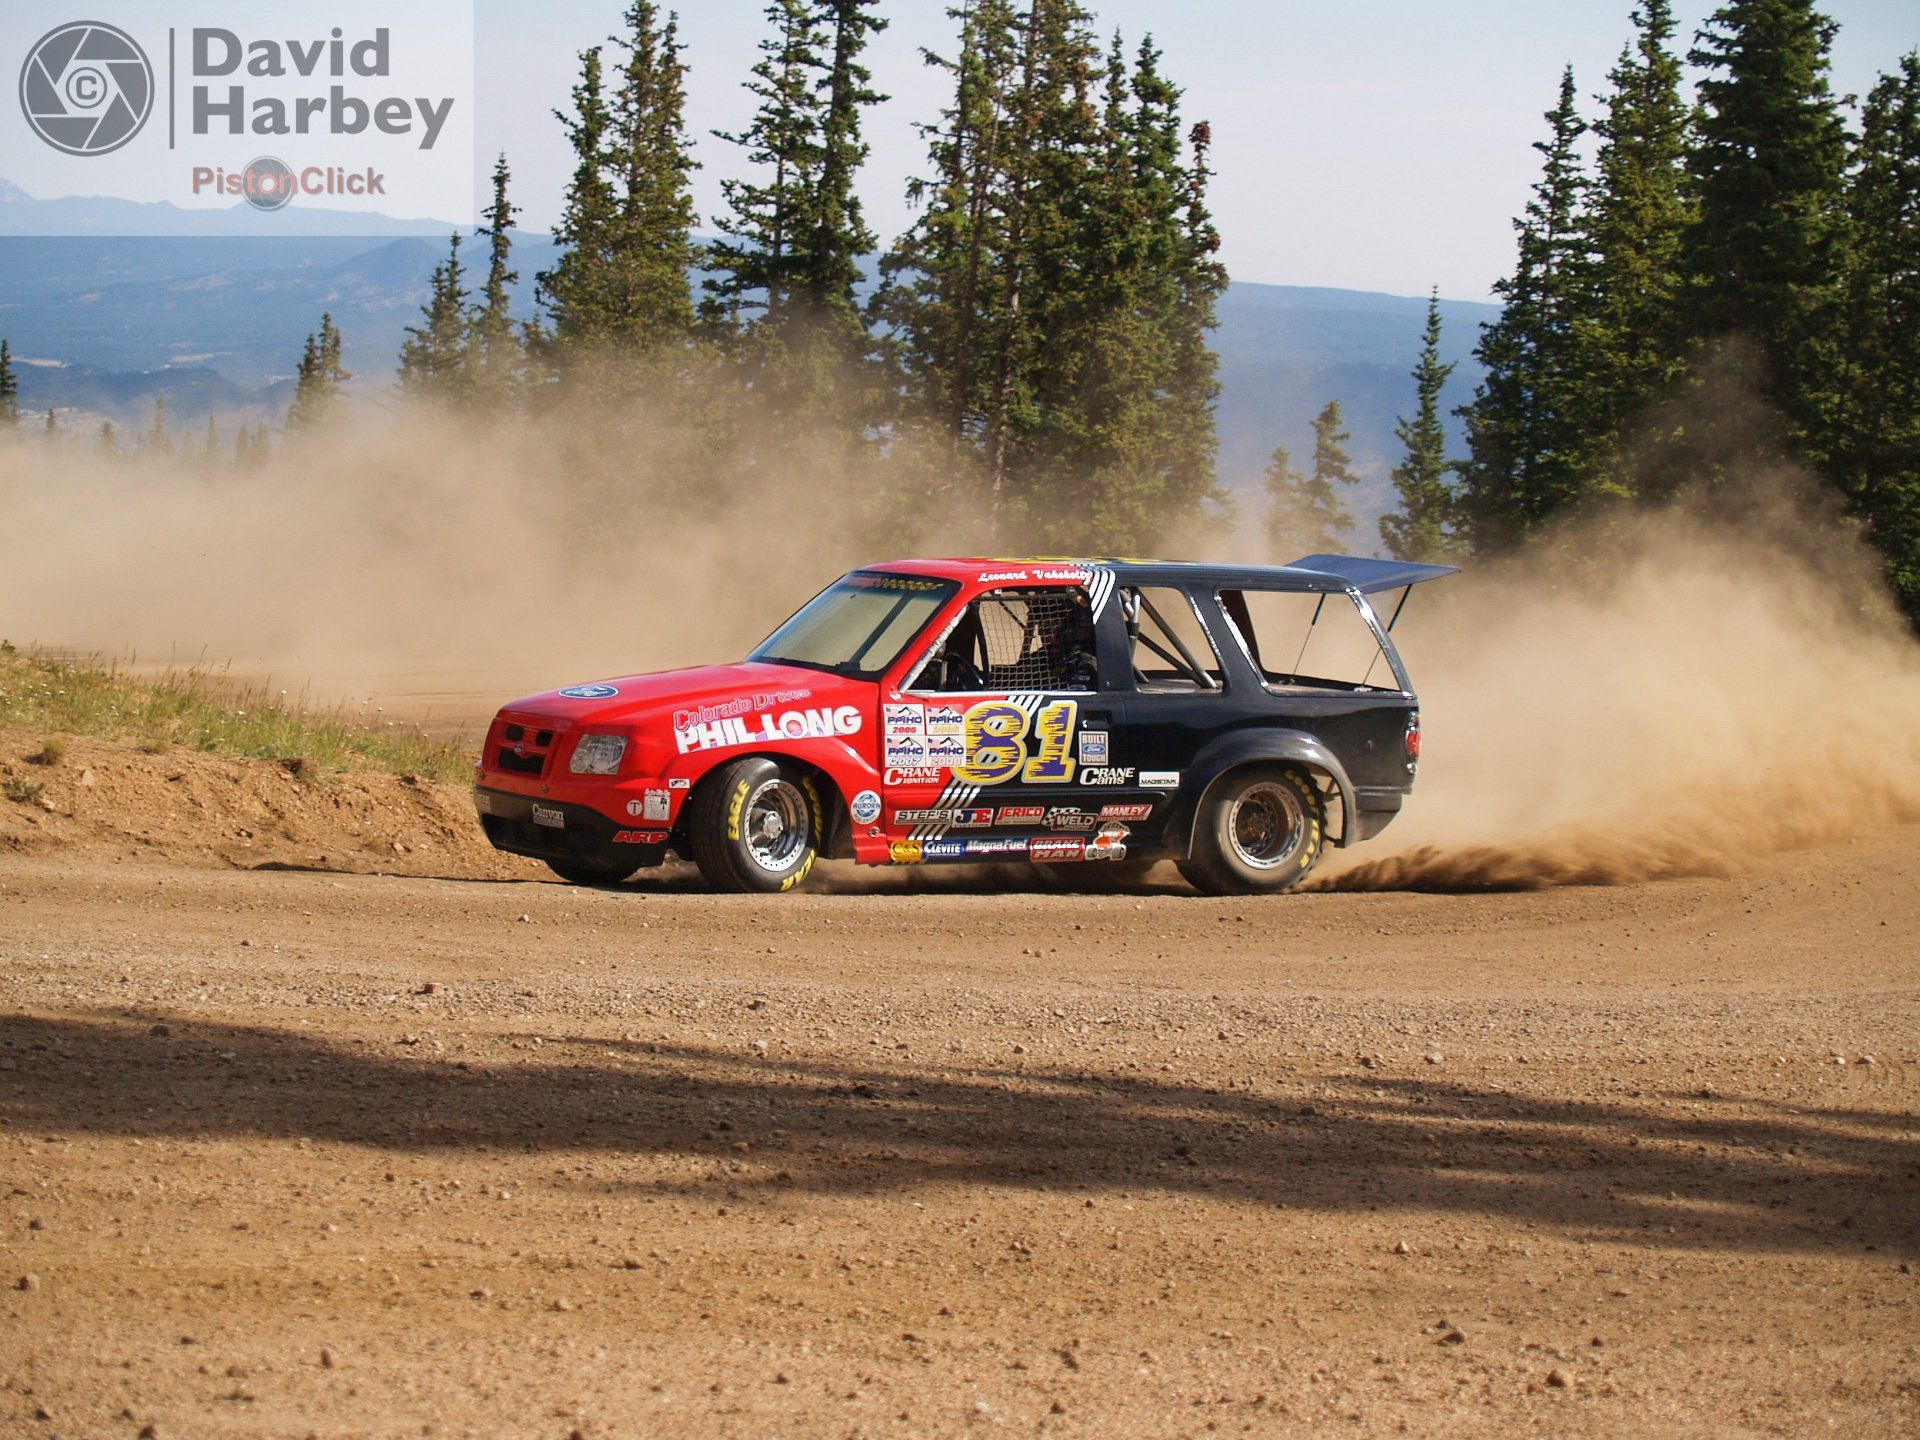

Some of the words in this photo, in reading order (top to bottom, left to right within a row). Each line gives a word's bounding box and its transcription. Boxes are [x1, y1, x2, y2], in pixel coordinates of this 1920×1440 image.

[977, 571, 1028, 583] Leonard
[673, 698, 753, 732] Colorado
[674, 717, 756, 755] PHIL
[760, 705, 862, 741] LONG
[949, 700, 1078, 786] 81
[1081, 734, 1105, 745] BUILT
[889, 757, 921, 767] 2007
[1081, 754, 1105, 763] TOUGH
[884, 767, 940, 785] CRANE
[1080, 767, 1136, 786] CRANE
[532, 803, 565, 821] Canyon
[727, 779, 751, 842] EAGLE
[898, 810, 949, 820] STEF'S
[955, 809, 991, 824] JE
[997, 807, 1043, 821] JERICO
[1102, 806, 1146, 816] MANLEY
[1056, 814, 1095, 826] WELD
[612, 830, 668, 844] ARP
[923, 841, 962, 854] CLEVITE
[964, 838, 1028, 853] MagnaFuel
[1034, 850, 1081, 859] MAN
